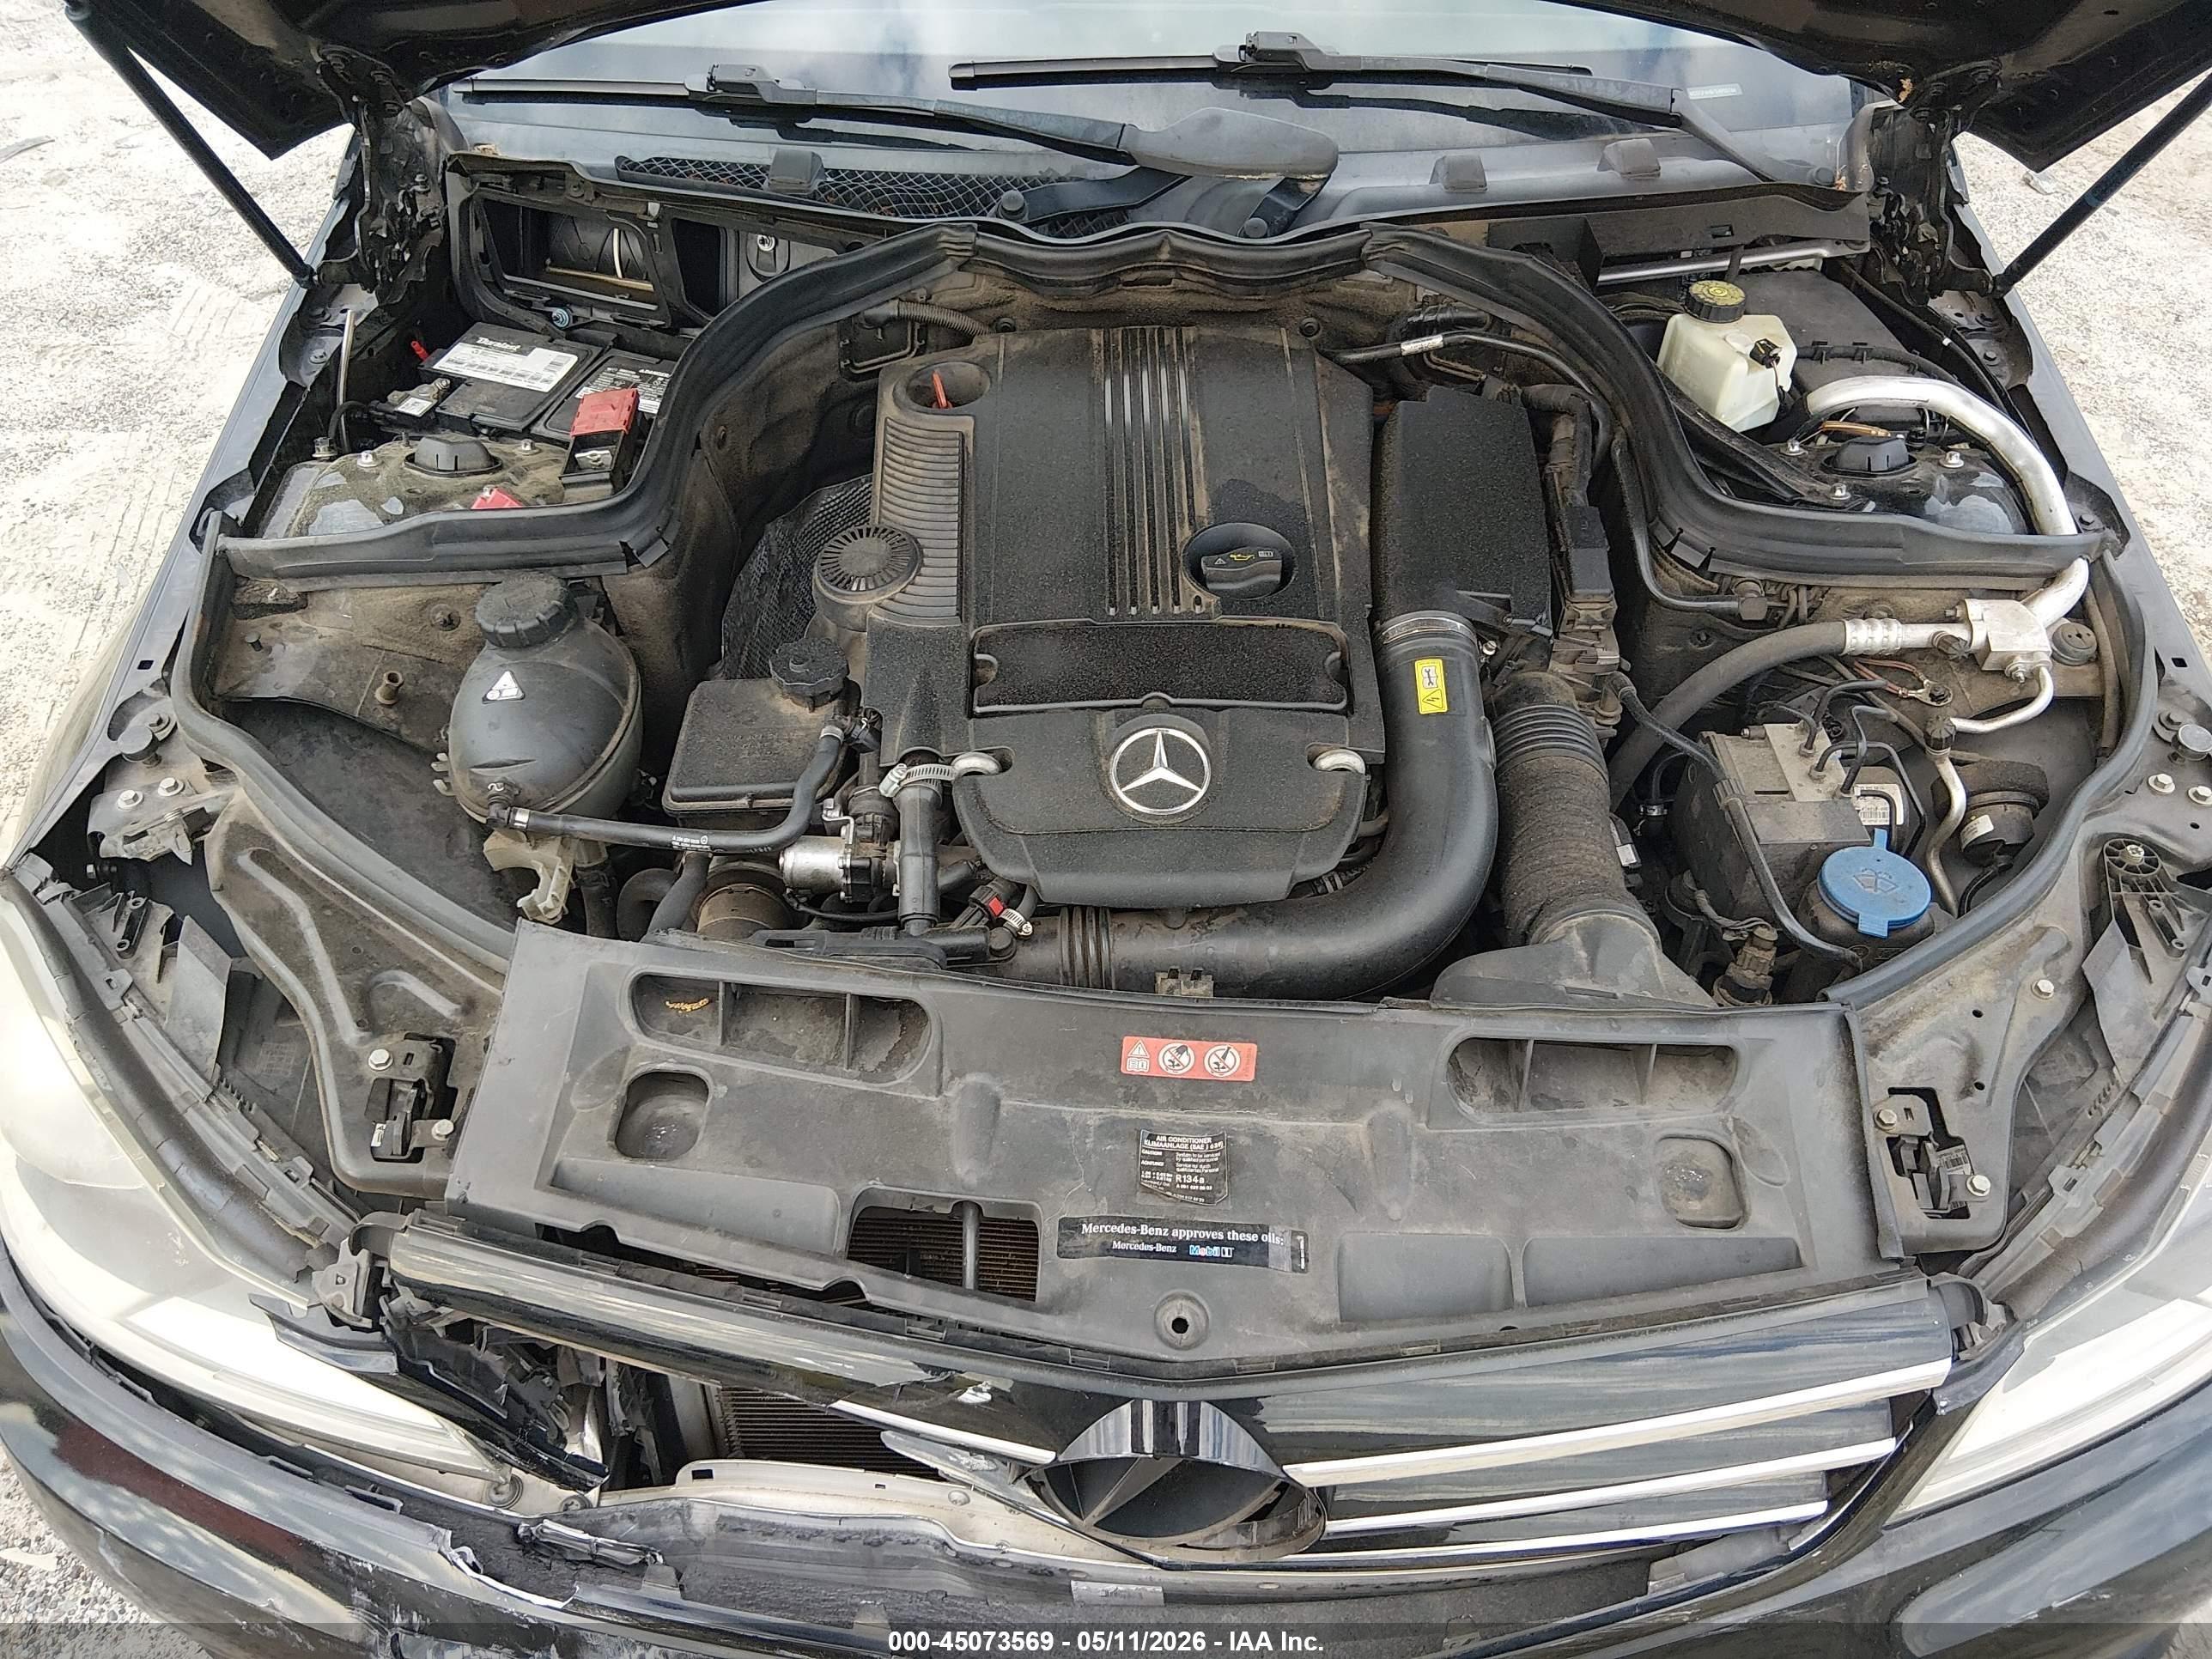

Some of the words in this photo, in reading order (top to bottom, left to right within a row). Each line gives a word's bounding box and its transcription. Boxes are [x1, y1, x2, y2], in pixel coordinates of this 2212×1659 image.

[1144, 1139, 1189, 1149] KLIMAANLAGE
[1176, 1174, 1205, 1184] R134a
[1081, 1223, 1170, 1237] Mercedes-Benz
[1172, 1226, 1224, 1241] approves
[1227, 1229, 1259, 1243] these
[1261, 1231, 1285, 1246] oils:
[1112, 1240, 1177, 1254] Mercedes-Benz
[1189, 1244, 1220, 1257] Mobil
